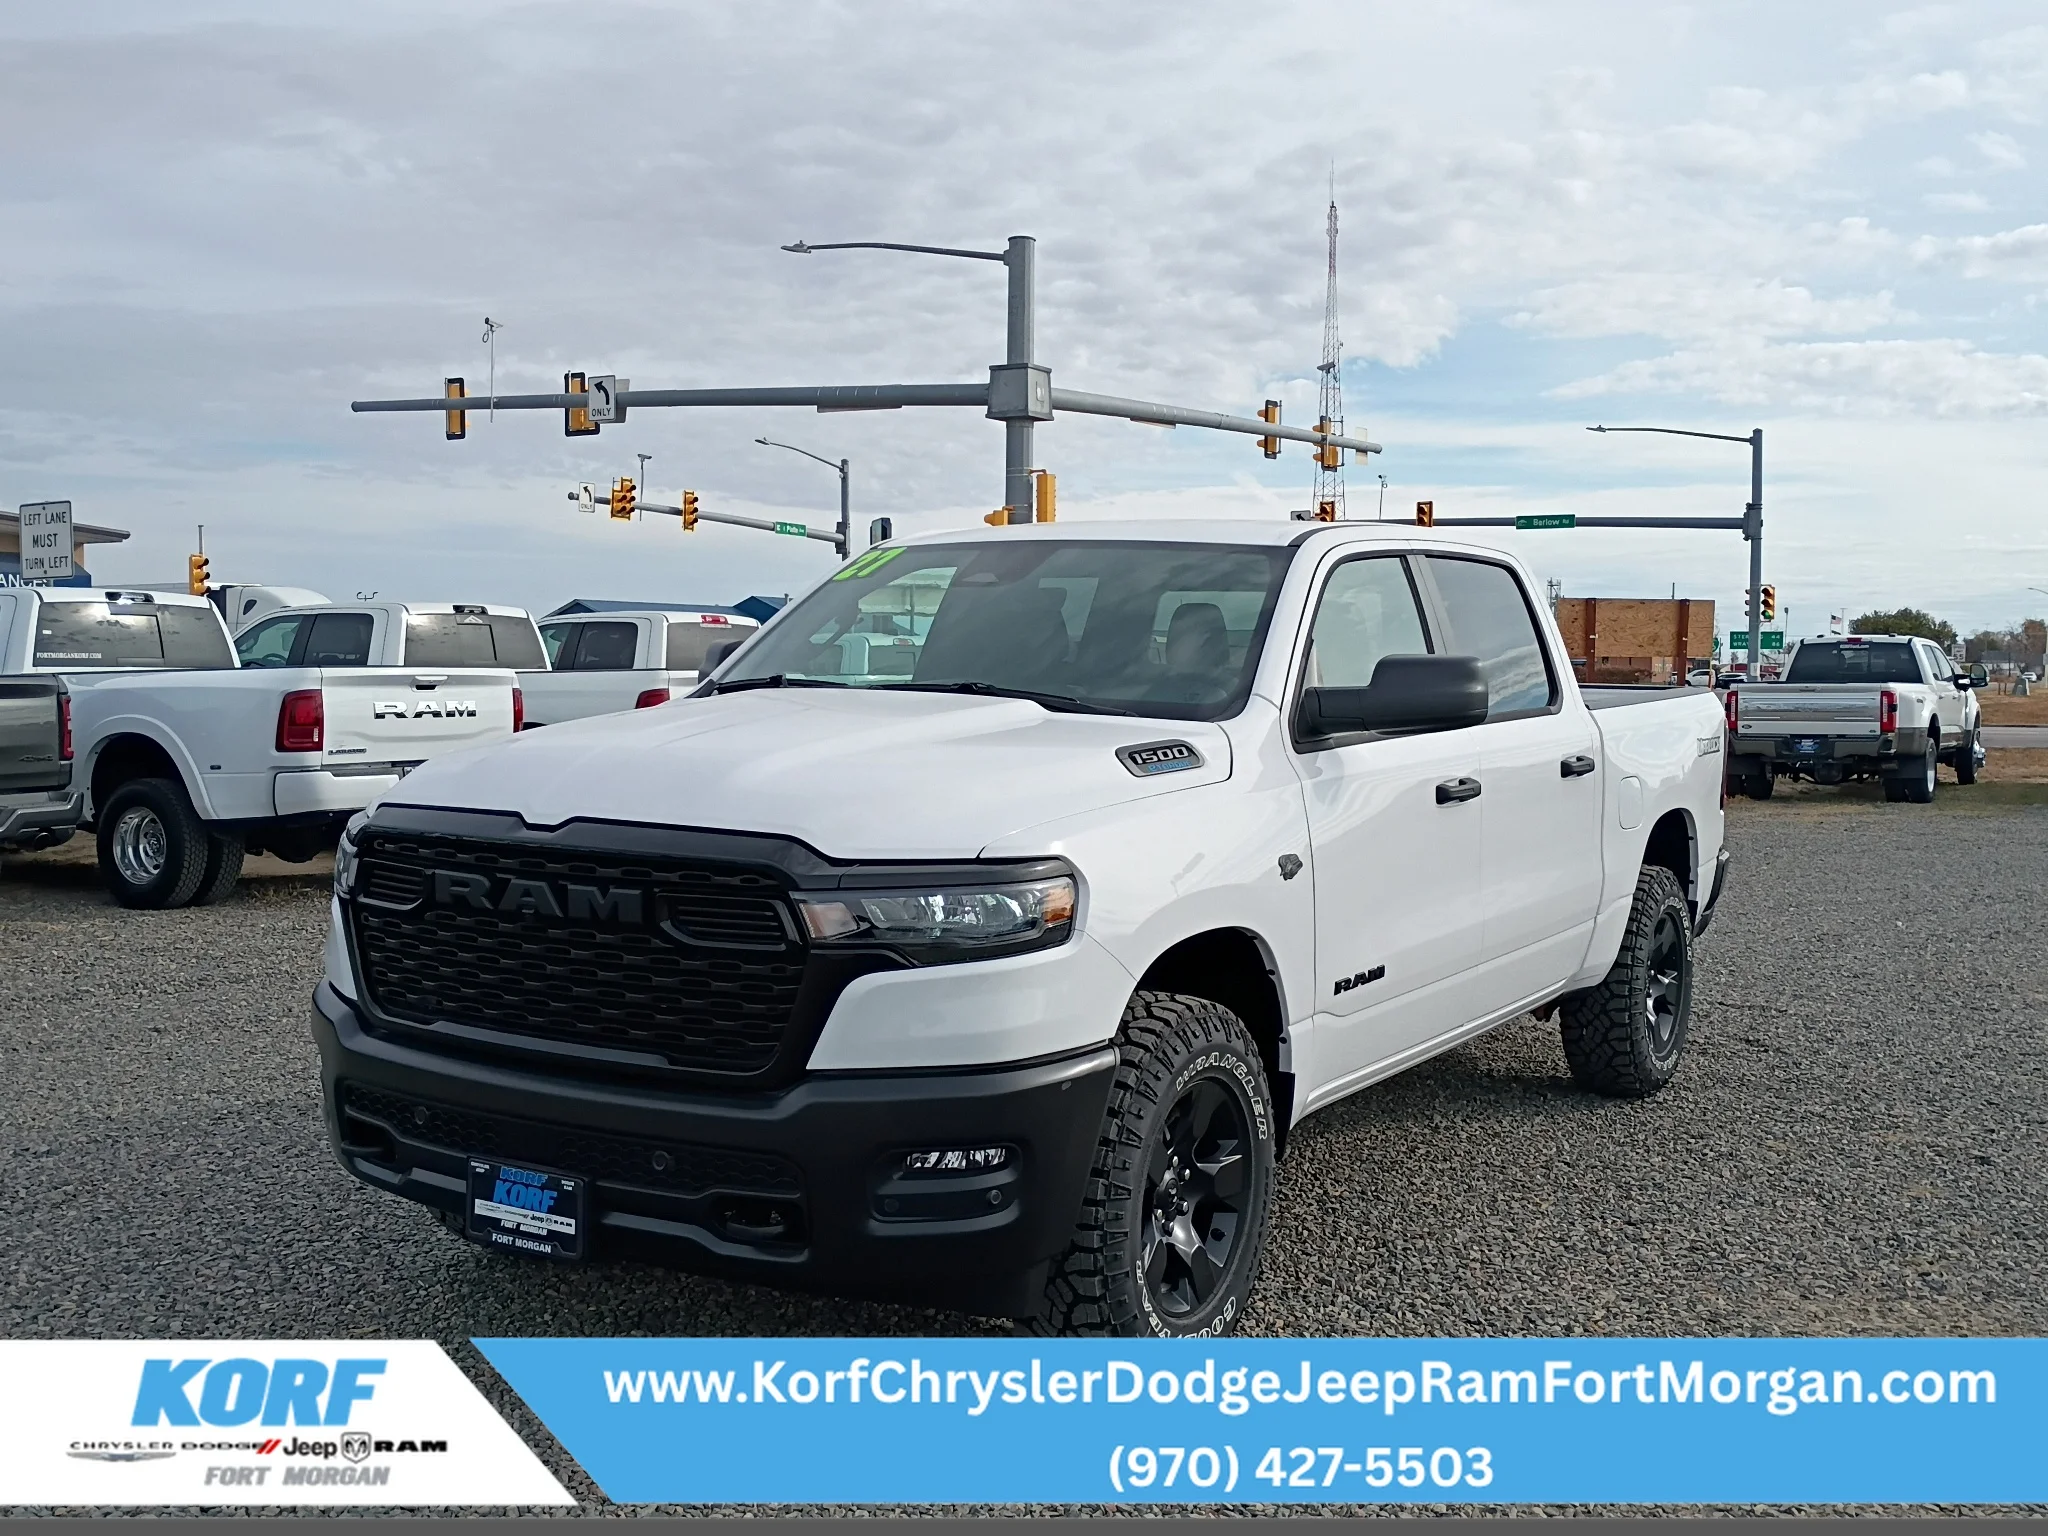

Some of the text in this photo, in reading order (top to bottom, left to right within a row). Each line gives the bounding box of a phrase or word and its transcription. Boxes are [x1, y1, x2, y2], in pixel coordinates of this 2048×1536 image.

[591, 408, 612, 417] ONLY
[24, 511, 67, 526] LEFT LANE
[1532, 518, 1560, 526] Barlow
[32, 533, 59, 548] MUST
[25, 555, 69, 570] TURN LEFT
[373, 700, 478, 720] RAM
[1132, 746, 1190, 765] 1500
[433, 868, 644, 924] RAM
[1333, 963, 1386, 996] RAM
[1175, 1051, 1268, 1141] WRANGLER
[499, 1165, 549, 1187] KORF
[493, 1180, 557, 1213] KORF
[500, 1219, 548, 1236] FORT MORGAN
[529, 1213, 545, 1224] Jeep
[492, 1232, 552, 1254] FORT MORGAN
